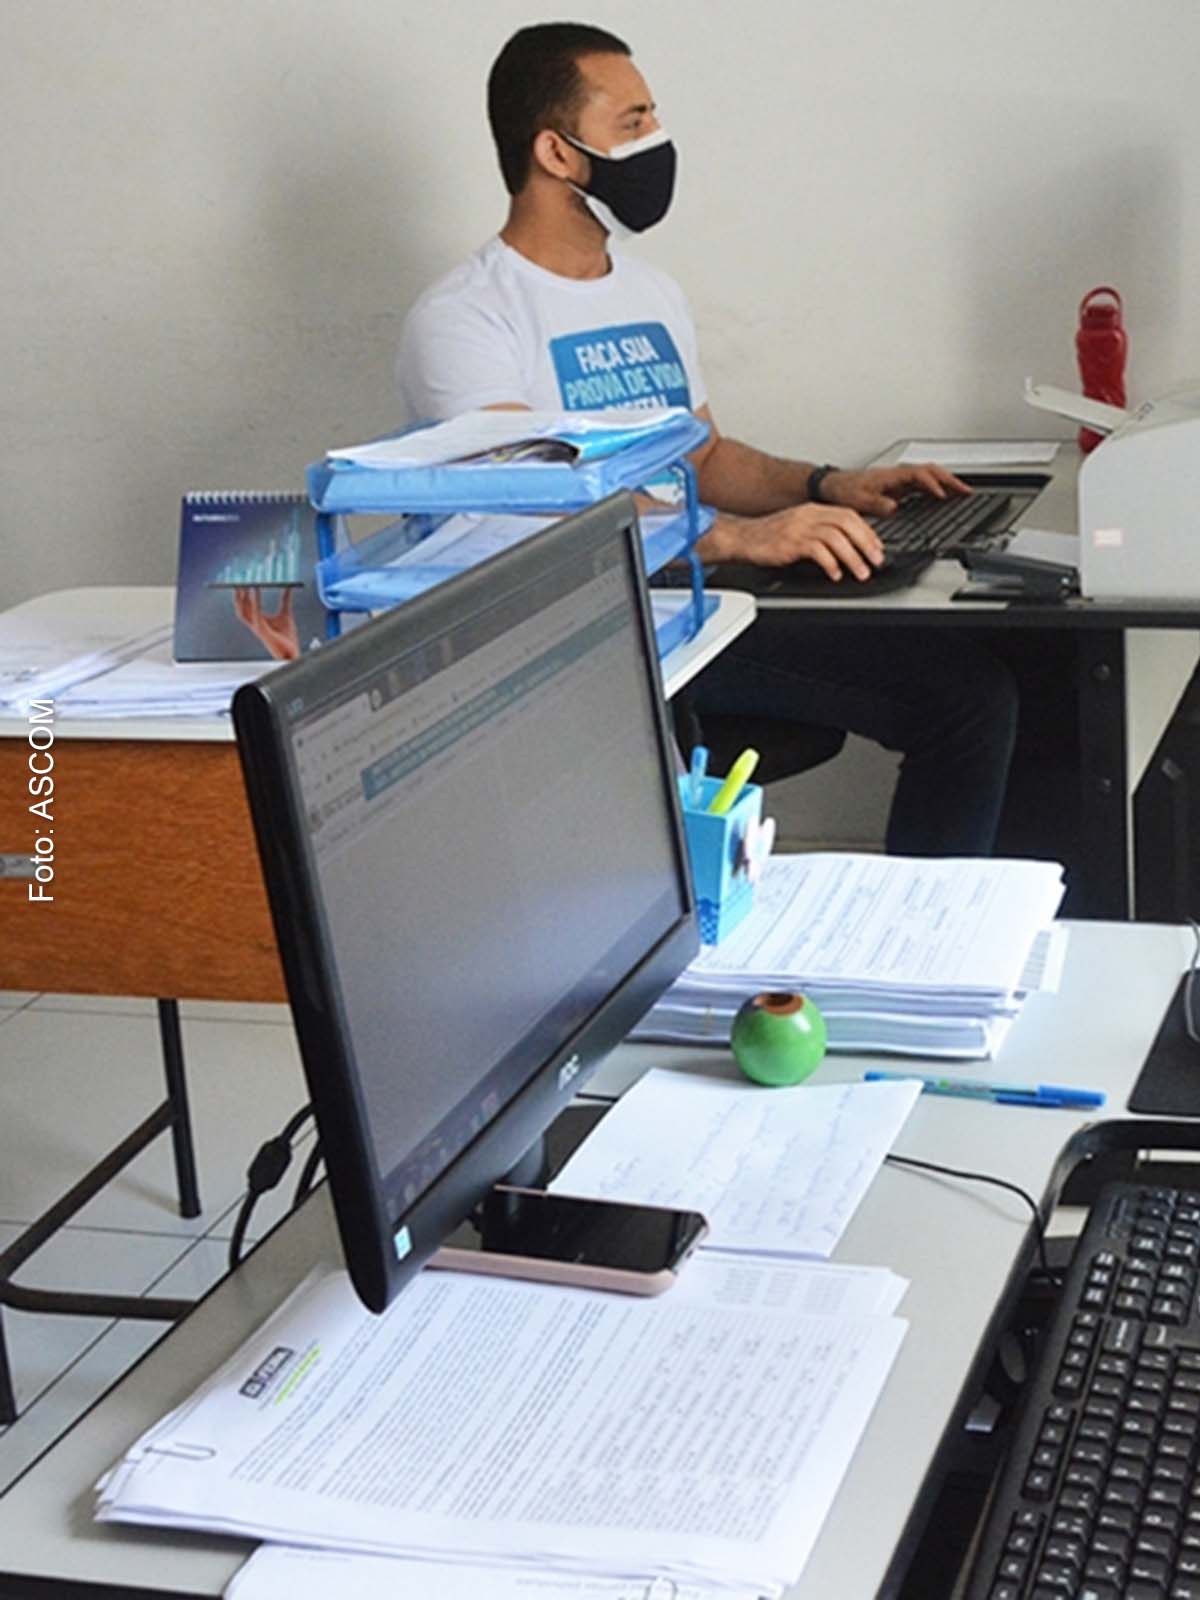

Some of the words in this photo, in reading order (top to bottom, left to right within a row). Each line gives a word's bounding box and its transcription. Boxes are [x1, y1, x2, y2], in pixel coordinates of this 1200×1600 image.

[574, 341, 625, 374] FAÇA
[619, 336, 660, 365] SUA
[565, 371, 628, 409] PROVA
[623, 366, 652, 396] DE
